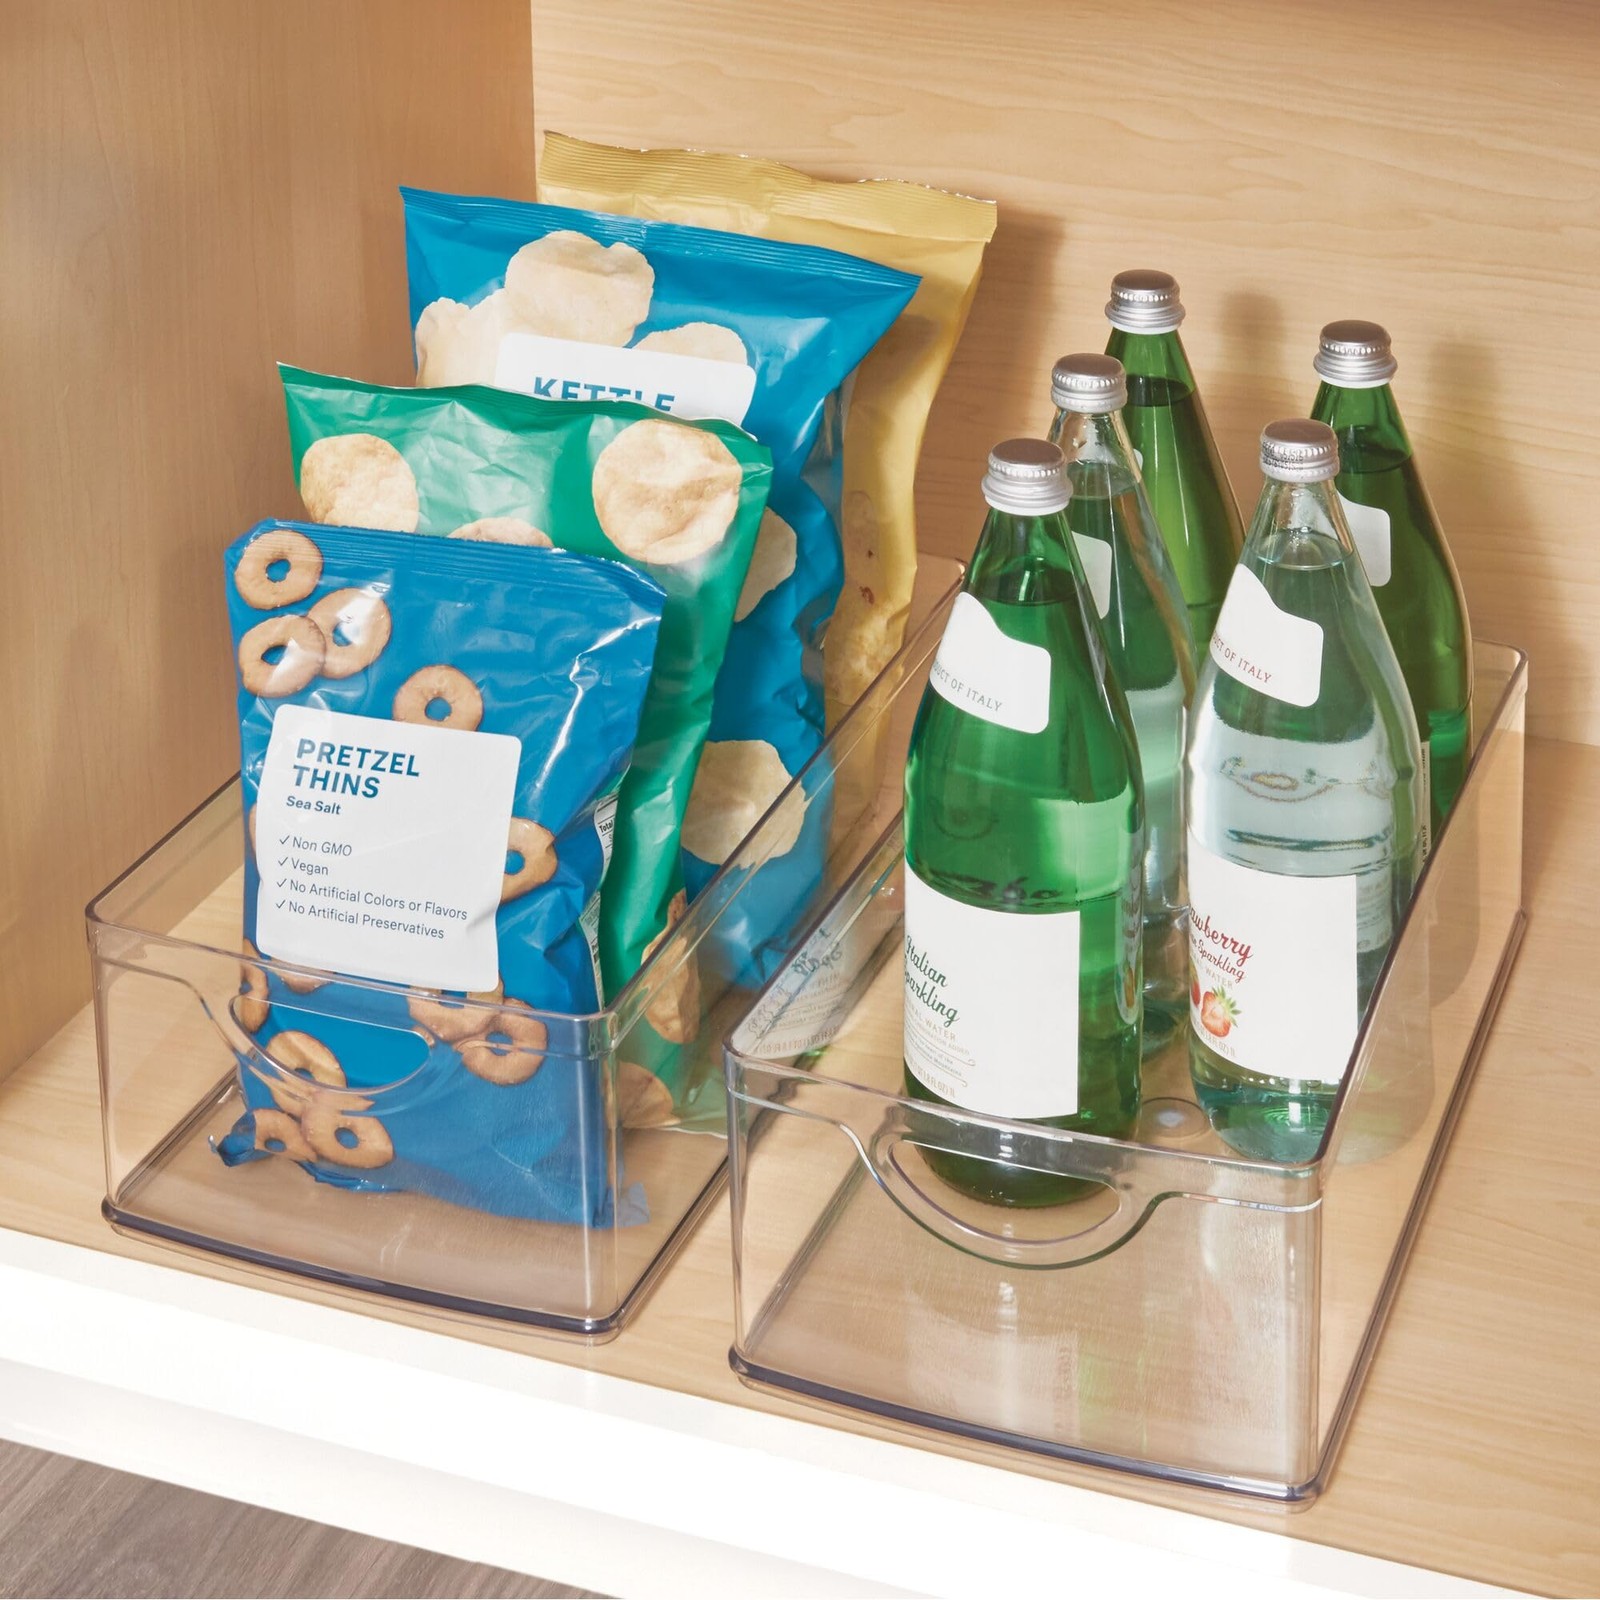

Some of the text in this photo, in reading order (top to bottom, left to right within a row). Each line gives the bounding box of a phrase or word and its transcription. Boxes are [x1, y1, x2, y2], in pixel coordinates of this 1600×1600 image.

[1224, 647, 1272, 683] OF ITALY
[951, 678, 965, 692] OF
[966, 687, 1003, 712] ITALY
[296, 738, 420, 777] PRETZEL
[293, 764, 381, 799] THINS
[286, 795, 342, 815] Sea Salt
[292, 836, 353, 857] Non GMO
[291, 857, 329, 876] Vegan
[290, 879, 468, 921] No Artificial Colors or Flavors
[288, 900, 445, 939] No Artificial Preservatives
[1189, 907, 1253, 967] awberry
[1198, 939, 1246, 984] Sparkling
[904, 965, 960, 1028] parkling
[925, 1019, 957, 1042] WATER
